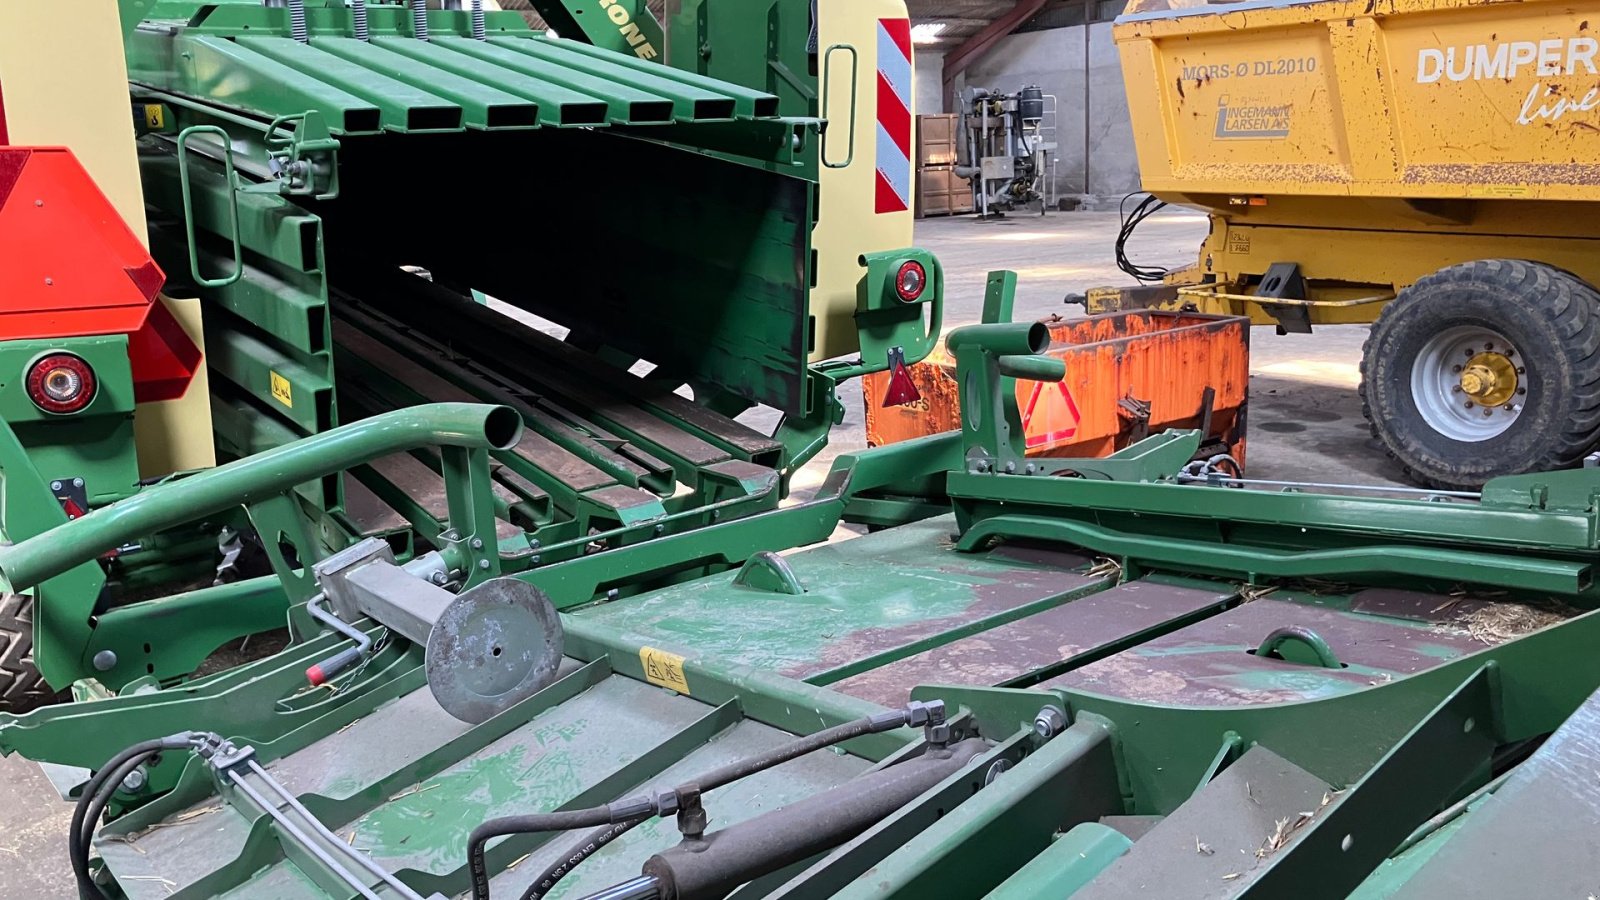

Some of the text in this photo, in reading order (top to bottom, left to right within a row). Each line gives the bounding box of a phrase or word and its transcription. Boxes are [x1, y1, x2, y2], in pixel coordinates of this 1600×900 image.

[1416, 37, 1599, 84] DUMPER
[1182, 57, 1316, 81] MORS-Ø DL2010
[1226, 119, 1269, 131] LARSEN
[582, 843, 595, 854] EN
[551, 868, 564, 879] SN
